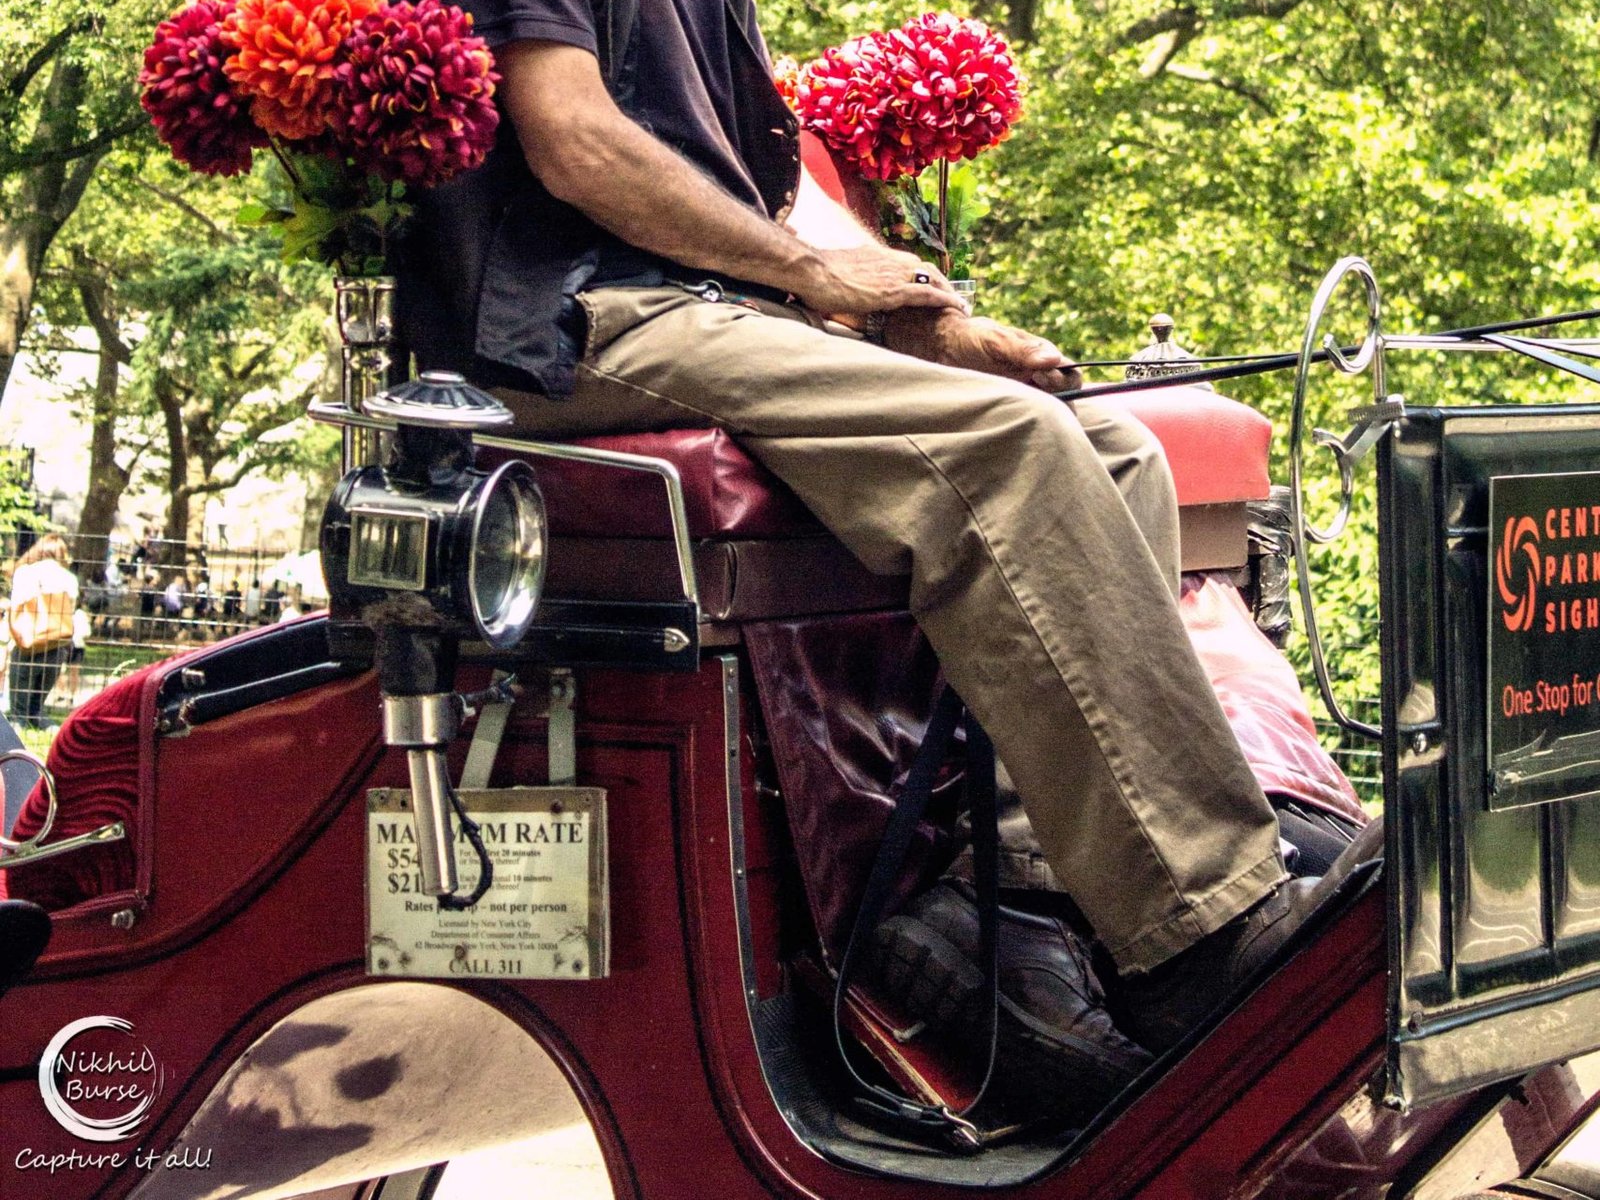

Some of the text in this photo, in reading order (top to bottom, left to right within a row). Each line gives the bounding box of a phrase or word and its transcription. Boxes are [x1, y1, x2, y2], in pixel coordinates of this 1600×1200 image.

[1545, 598, 1598, 633] SIGH
[1503, 684, 1533, 718] One
[1536, 680, 1569, 716] Stop
[1573, 673, 1593, 705] for
[516, 822, 583, 844] RATE
[512, 849, 541, 857] minutes
[405, 900, 433, 911] Rates
[490, 902, 506, 912] not
[510, 903, 528, 915] per
[531, 903, 567, 915] person
[449, 959, 521, 974] CALL 311
